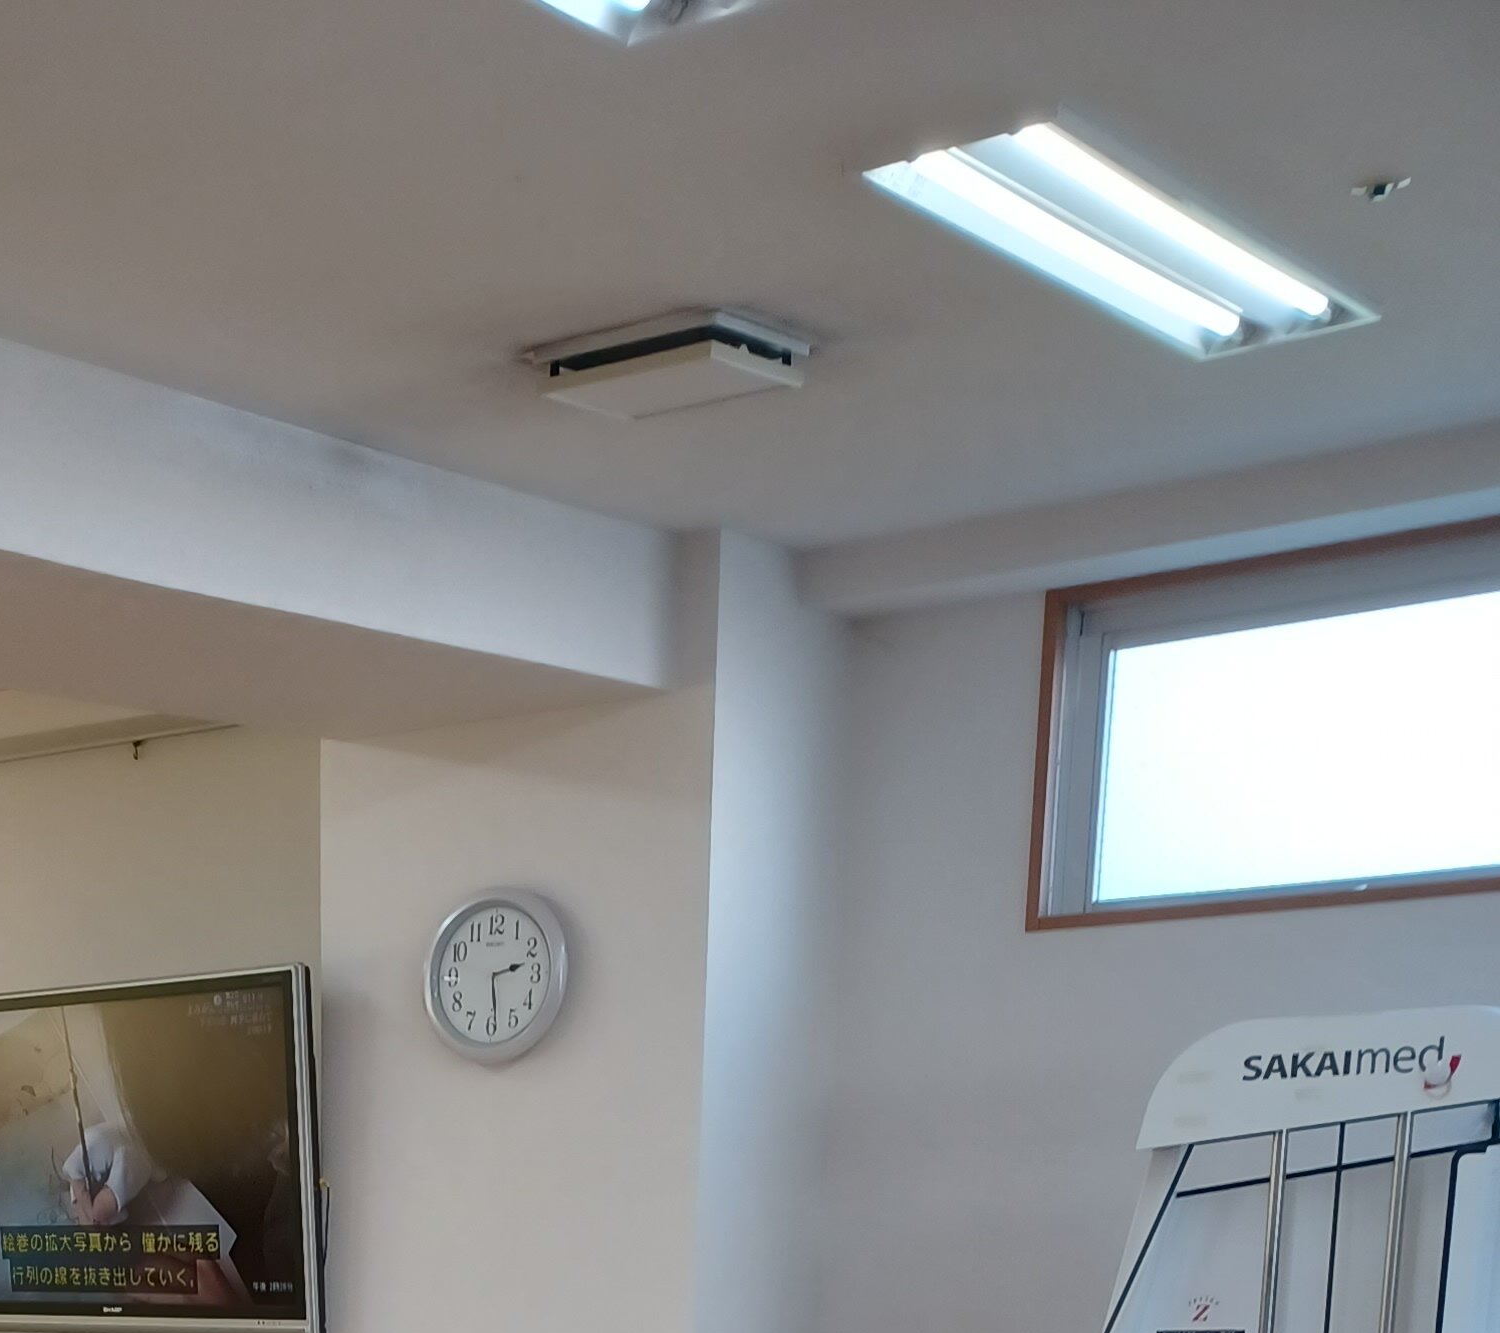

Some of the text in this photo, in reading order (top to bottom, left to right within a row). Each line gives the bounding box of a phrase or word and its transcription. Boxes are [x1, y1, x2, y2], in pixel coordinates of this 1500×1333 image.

[469, 921, 482, 943] 11
[489, 914, 505, 936] 12
[515, 920, 520, 940] 1
[452, 941, 468, 962] 10
[526, 937, 537, 958] 2
[530, 963, 541, 984] 3
[451, 991, 463, 1012] 8
[523, 988, 532, 1010] 4
[466, 1011, 476, 1031] 7
[485, 1009, 497, 1036] 6
[508, 1008, 519, 1029] 5
[1242, 1036, 1445, 1081] SAKAImed
[2, 1231, 132, 1253] 絵巻の拡大写真から
